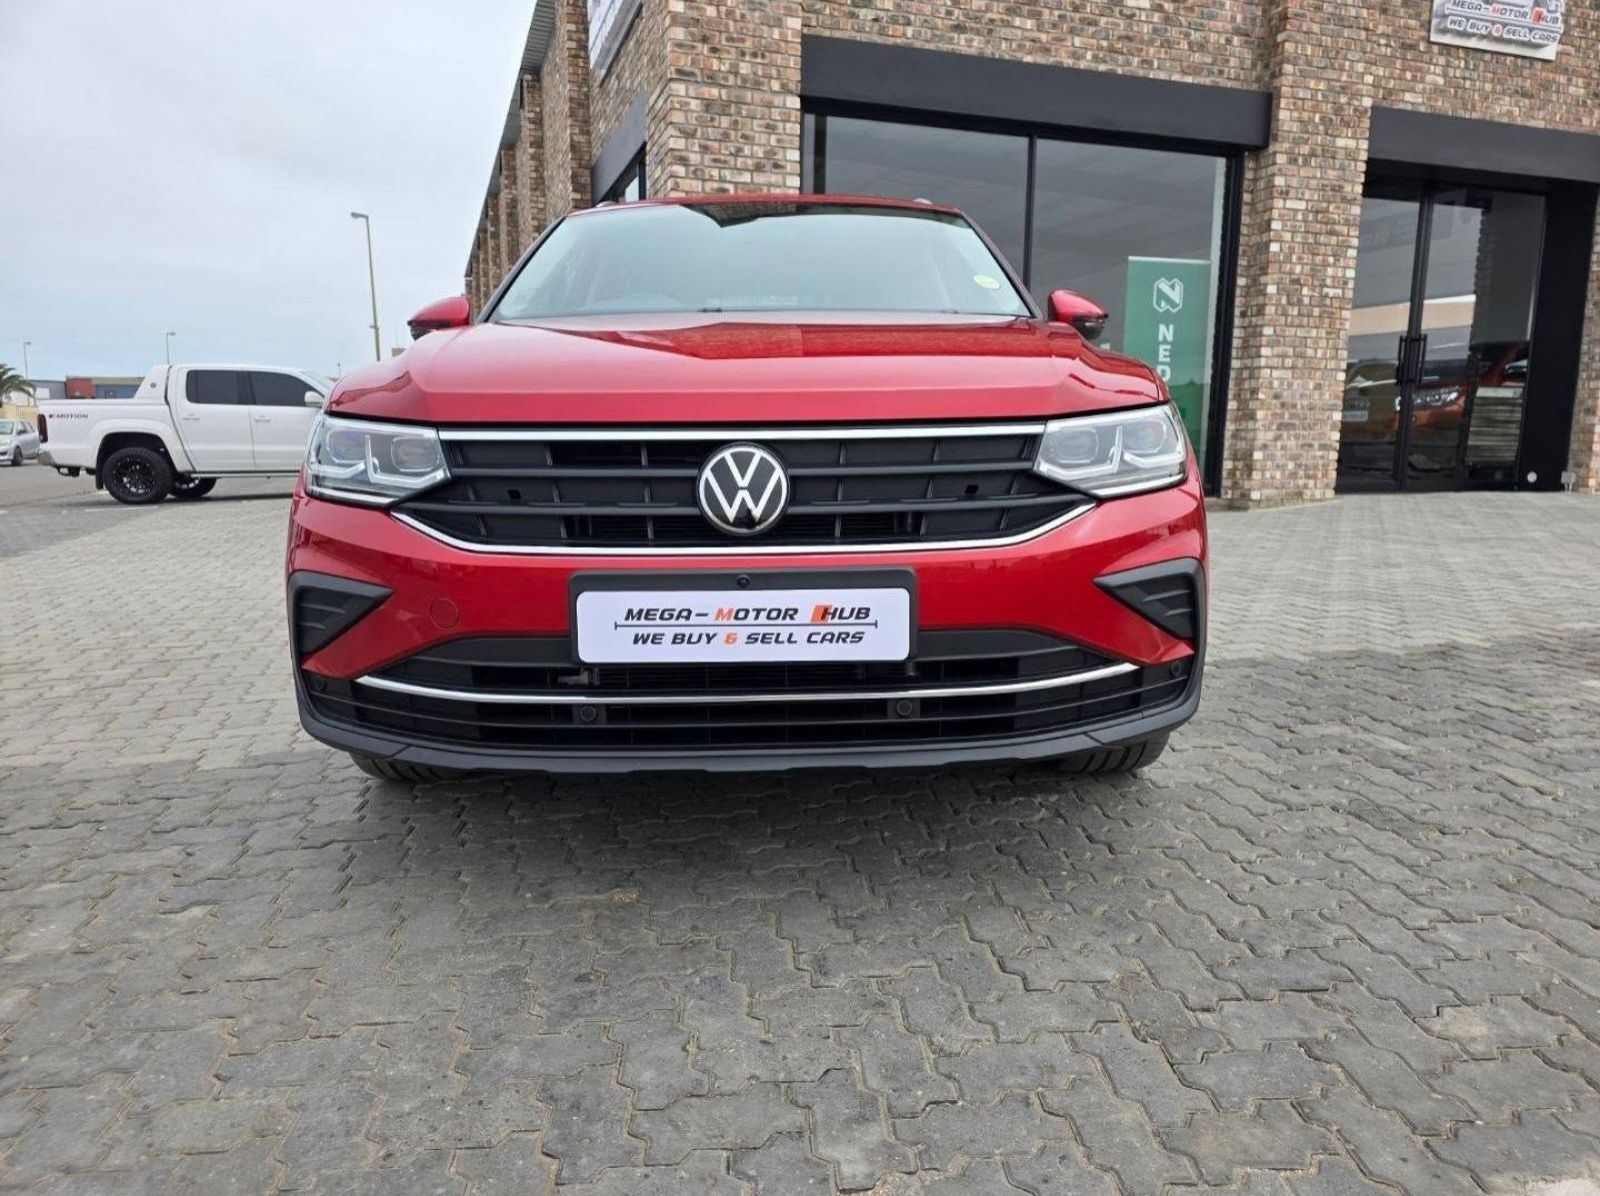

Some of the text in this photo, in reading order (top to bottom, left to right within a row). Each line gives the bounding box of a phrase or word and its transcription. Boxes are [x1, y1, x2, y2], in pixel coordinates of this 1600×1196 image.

[1491, 5, 1529, 19] MOTOR
[1449, 18, 1463, 27] WE
[1469, 22, 1490, 32] BUY
[1505, 27, 1529, 38] SELL
[1532, 31, 1558, 43] CARS
[715, 608, 799, 620] MOTOR
[819, 607, 871, 620] HUB
[632, 632, 665, 645] WE
[671, 632, 718, 645] BUY
[745, 632, 798, 645] SELL
[806, 631, 865, 644] CARS
